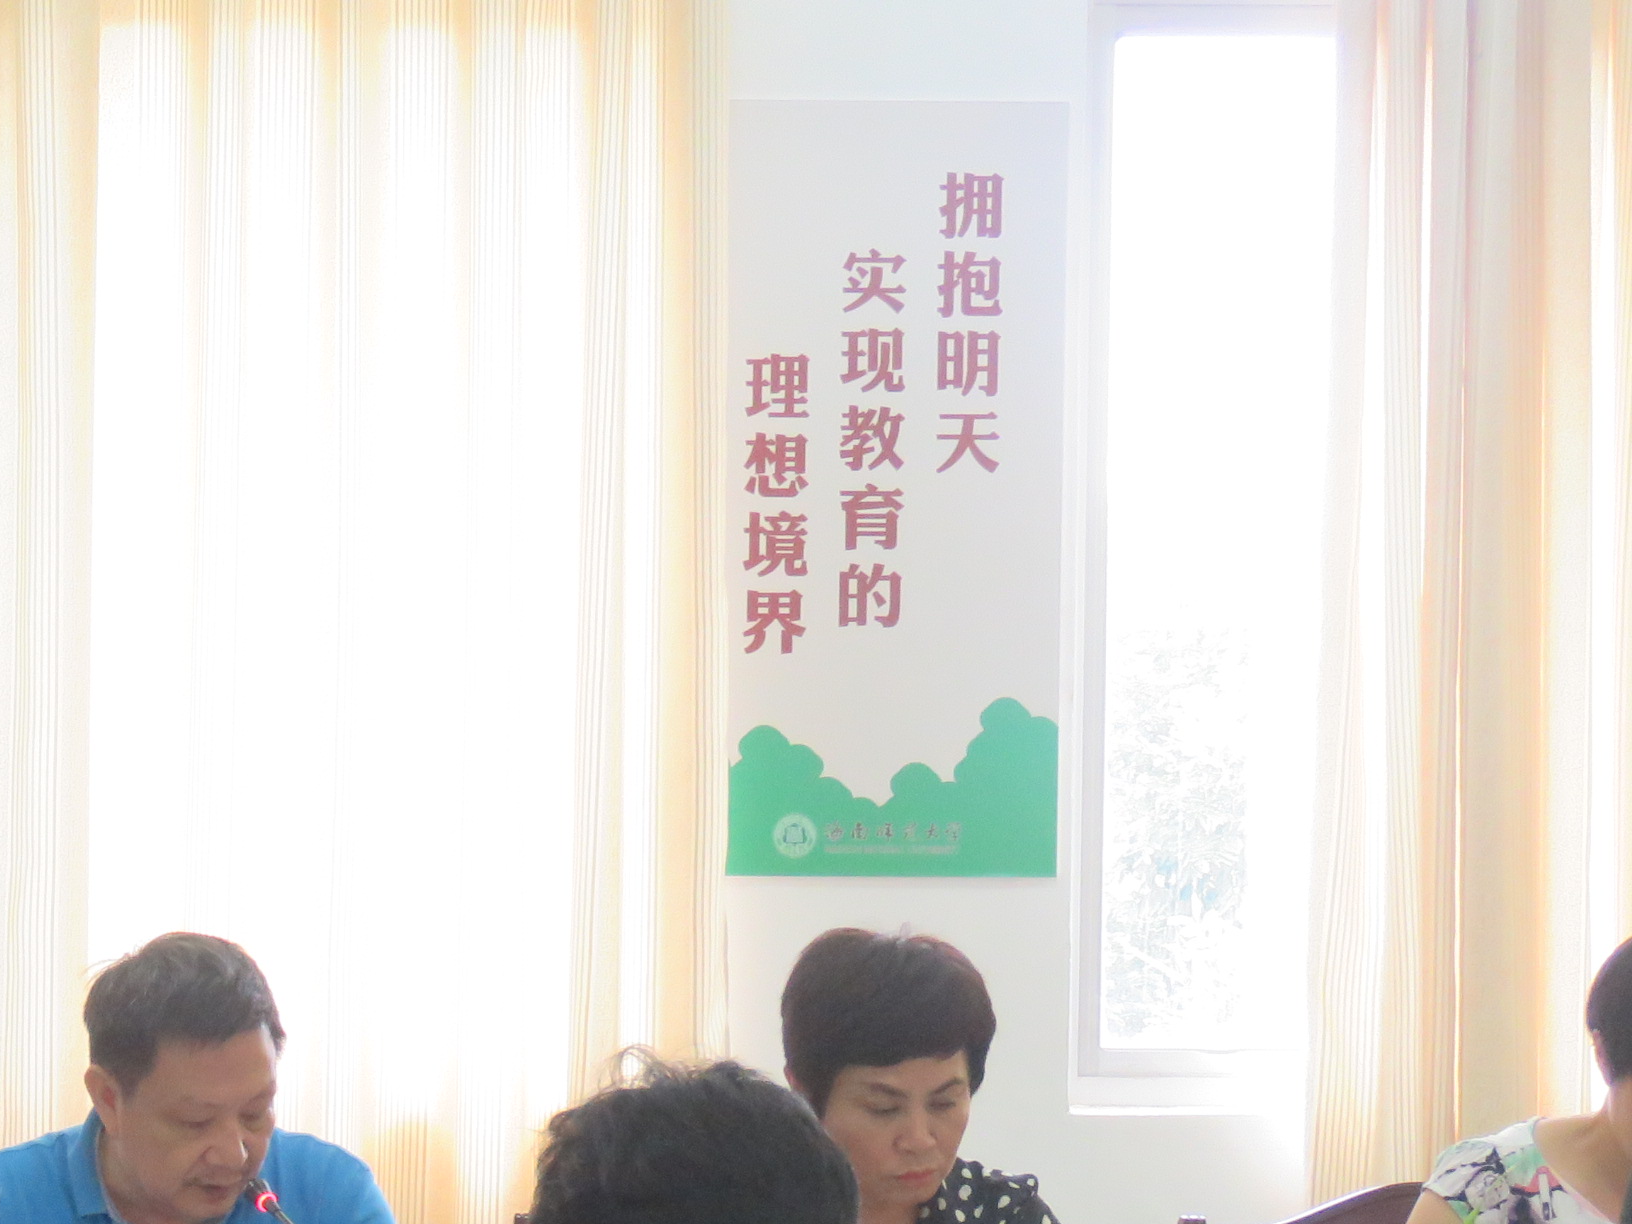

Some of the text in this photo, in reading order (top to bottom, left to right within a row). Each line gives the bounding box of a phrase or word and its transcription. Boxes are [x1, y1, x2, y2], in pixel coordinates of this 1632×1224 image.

[838, 248, 907, 629] 实现教育的
[936, 173, 1003, 473] 拥抱明天
[742, 352, 811, 655] 理想境界
